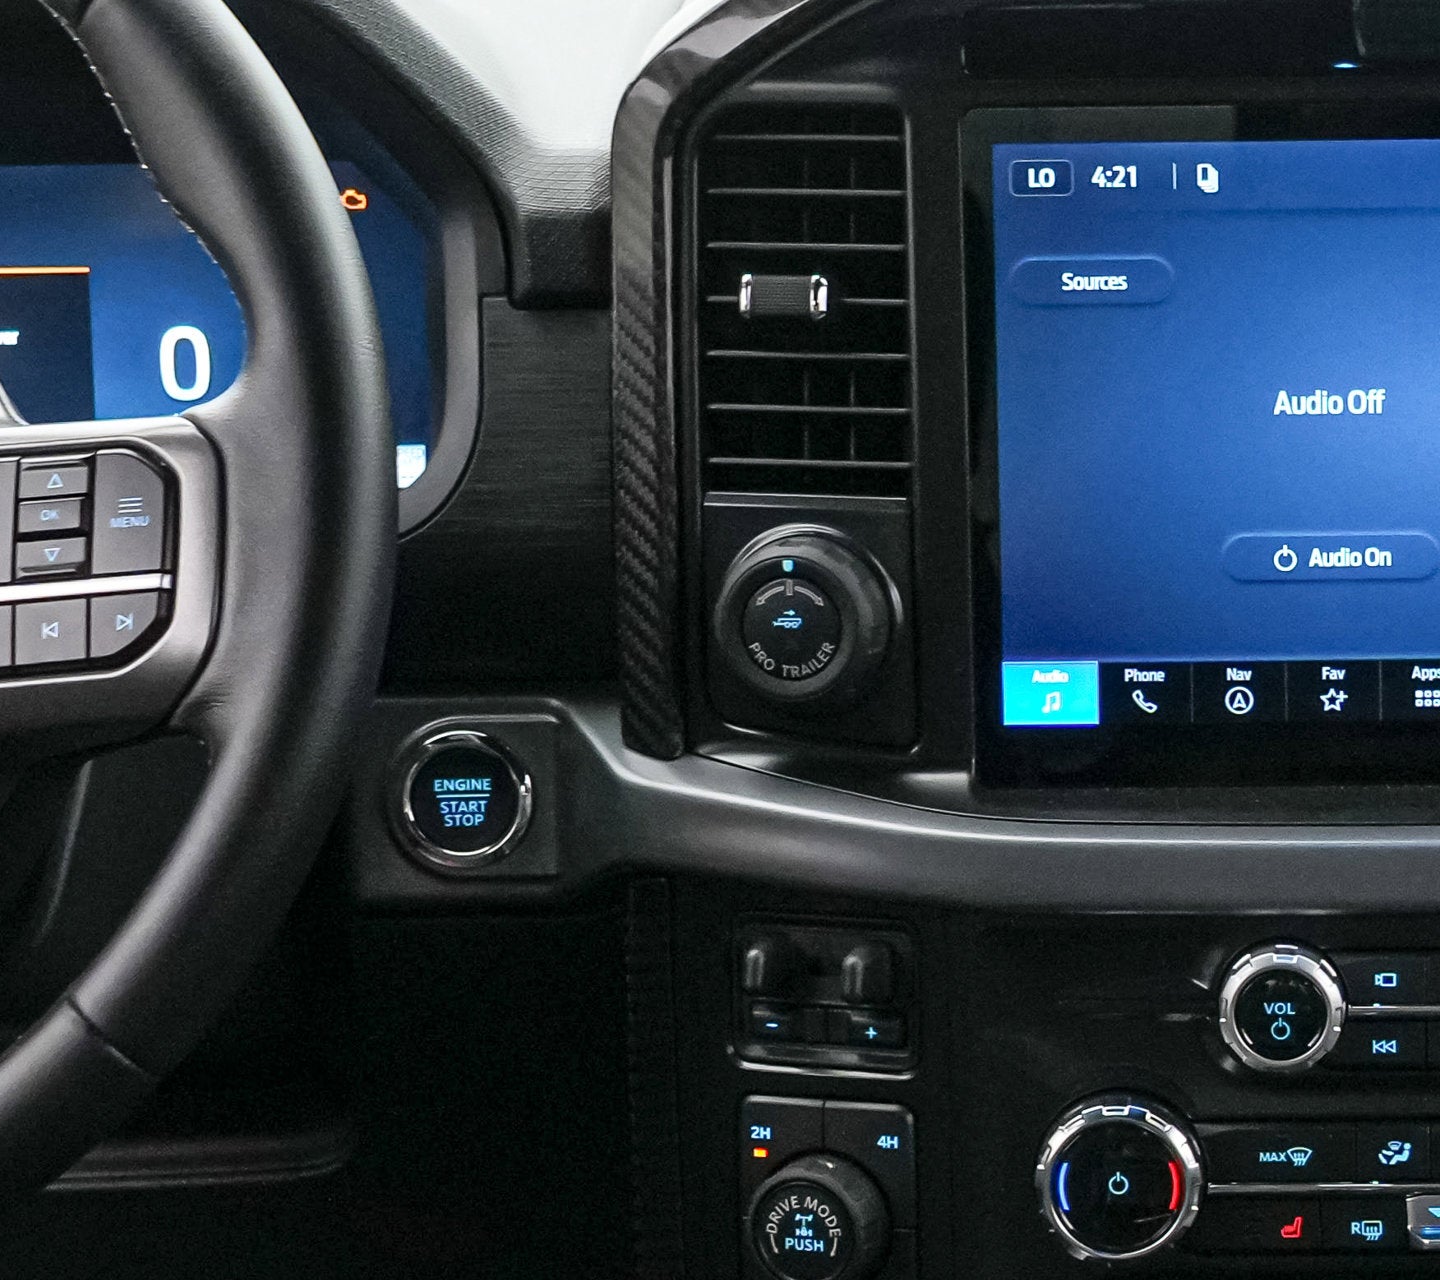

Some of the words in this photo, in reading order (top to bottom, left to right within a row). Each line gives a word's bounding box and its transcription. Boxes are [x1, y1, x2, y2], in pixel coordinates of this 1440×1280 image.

[1027, 168, 1055, 189] LO
[1092, 166, 1138, 189] 4:21
[1061, 271, 1128, 292] Sources
[160, 325, 210, 401] 0
[1274, 389, 1342, 417] Audio
[1346, 388, 1386, 417] Off
[1309, 546, 1359, 569] Audio
[1364, 547, 1392, 569] On
[749, 642, 775, 671] PRO
[782, 642, 836, 678] TRAILER
[1031, 669, 1069, 684] Audio
[1124, 667, 1165, 683] Phone
[1226, 666, 1252, 682] Nav
[1322, 666, 1345, 681] Fav
[433, 778, 492, 792] ENGINE
[440, 800, 488, 814] START
[444, 814, 485, 827] STOP
[1263, 1002, 1296, 1015] VOL
[750, 1126, 771, 1140] 2H
[877, 1135, 898, 1149] 4H
[1259, 1151, 1287, 1163] MAX
[766, 1195, 800, 1235] DRIVE
[804, 1195, 842, 1237] MODE
[784, 1238, 824, 1252] PUSH
